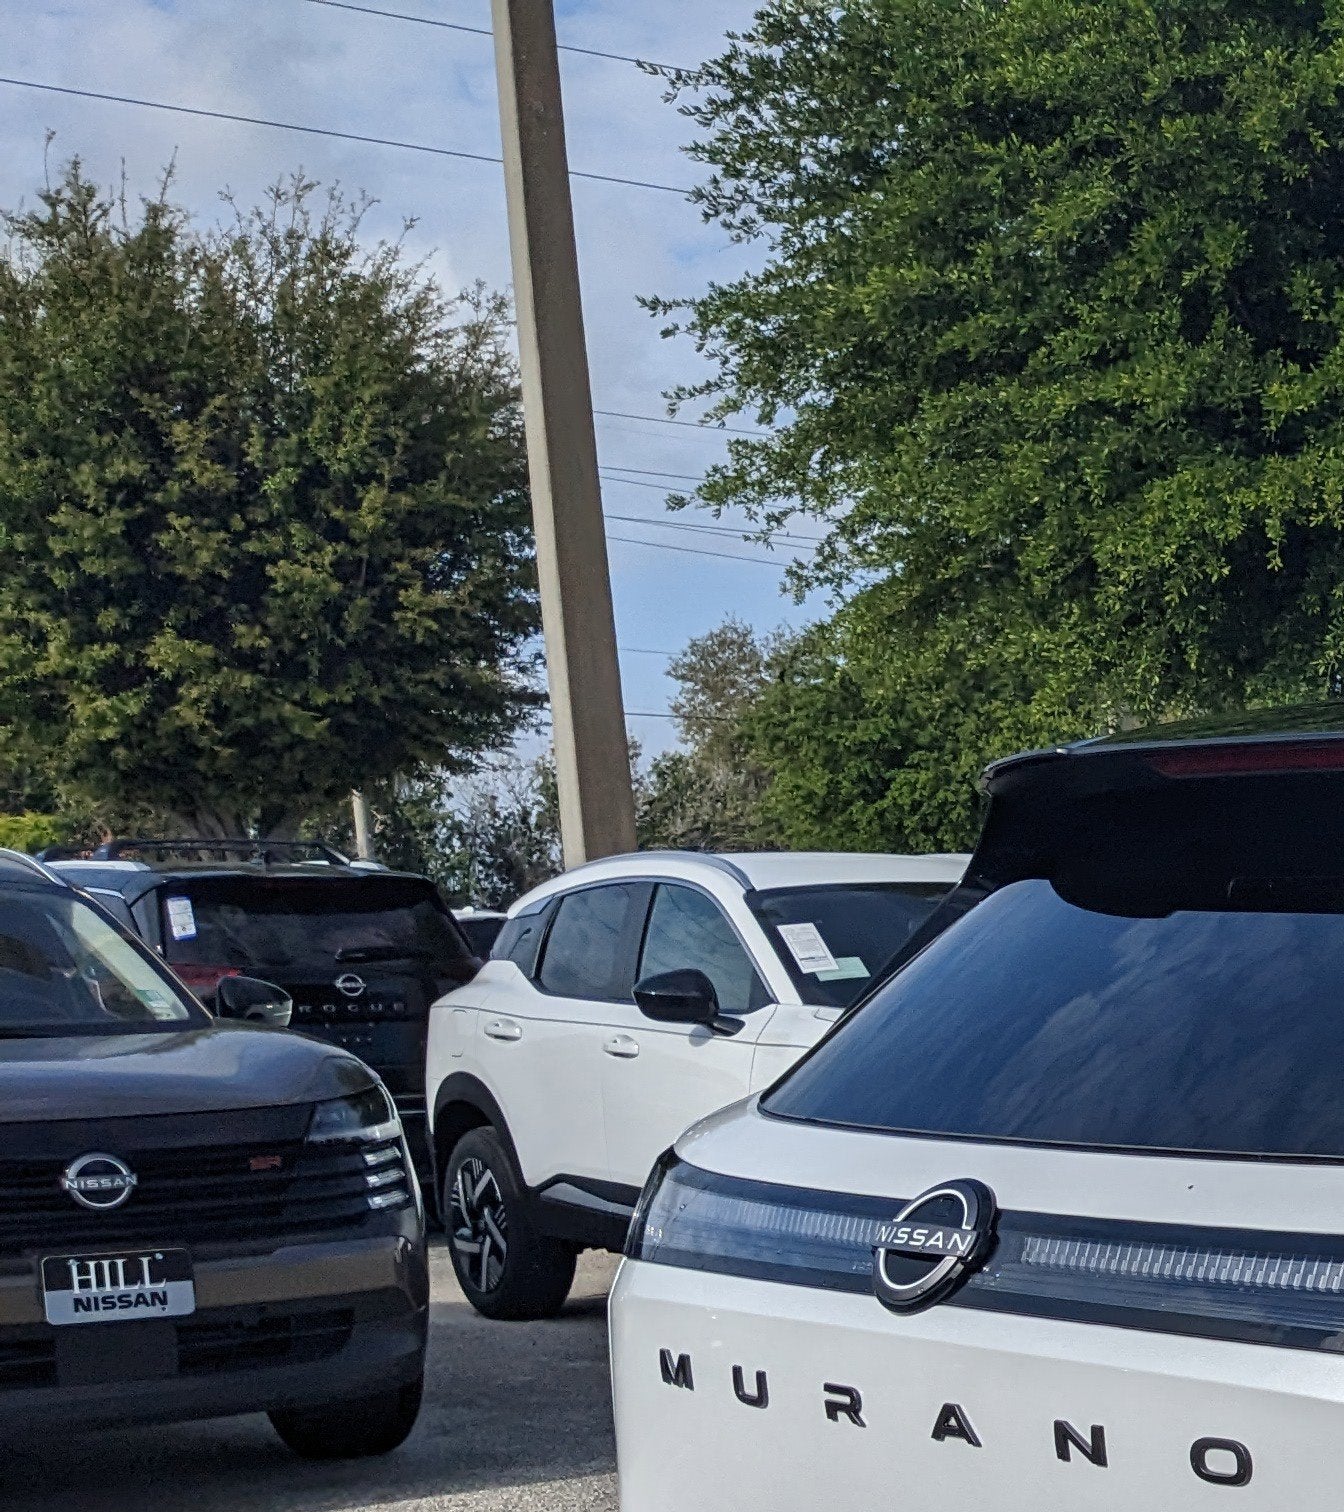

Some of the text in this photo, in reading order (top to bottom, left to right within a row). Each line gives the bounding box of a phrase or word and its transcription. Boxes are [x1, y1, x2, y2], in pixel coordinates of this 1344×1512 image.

[65, 1176, 137, 1189] NISSAN
[875, 1225, 972, 1251] NISSAN
[69, 1256, 166, 1293] HILL
[73, 1290, 169, 1313] NISSAN
[659, 1347, 1254, 1487] MURANO
